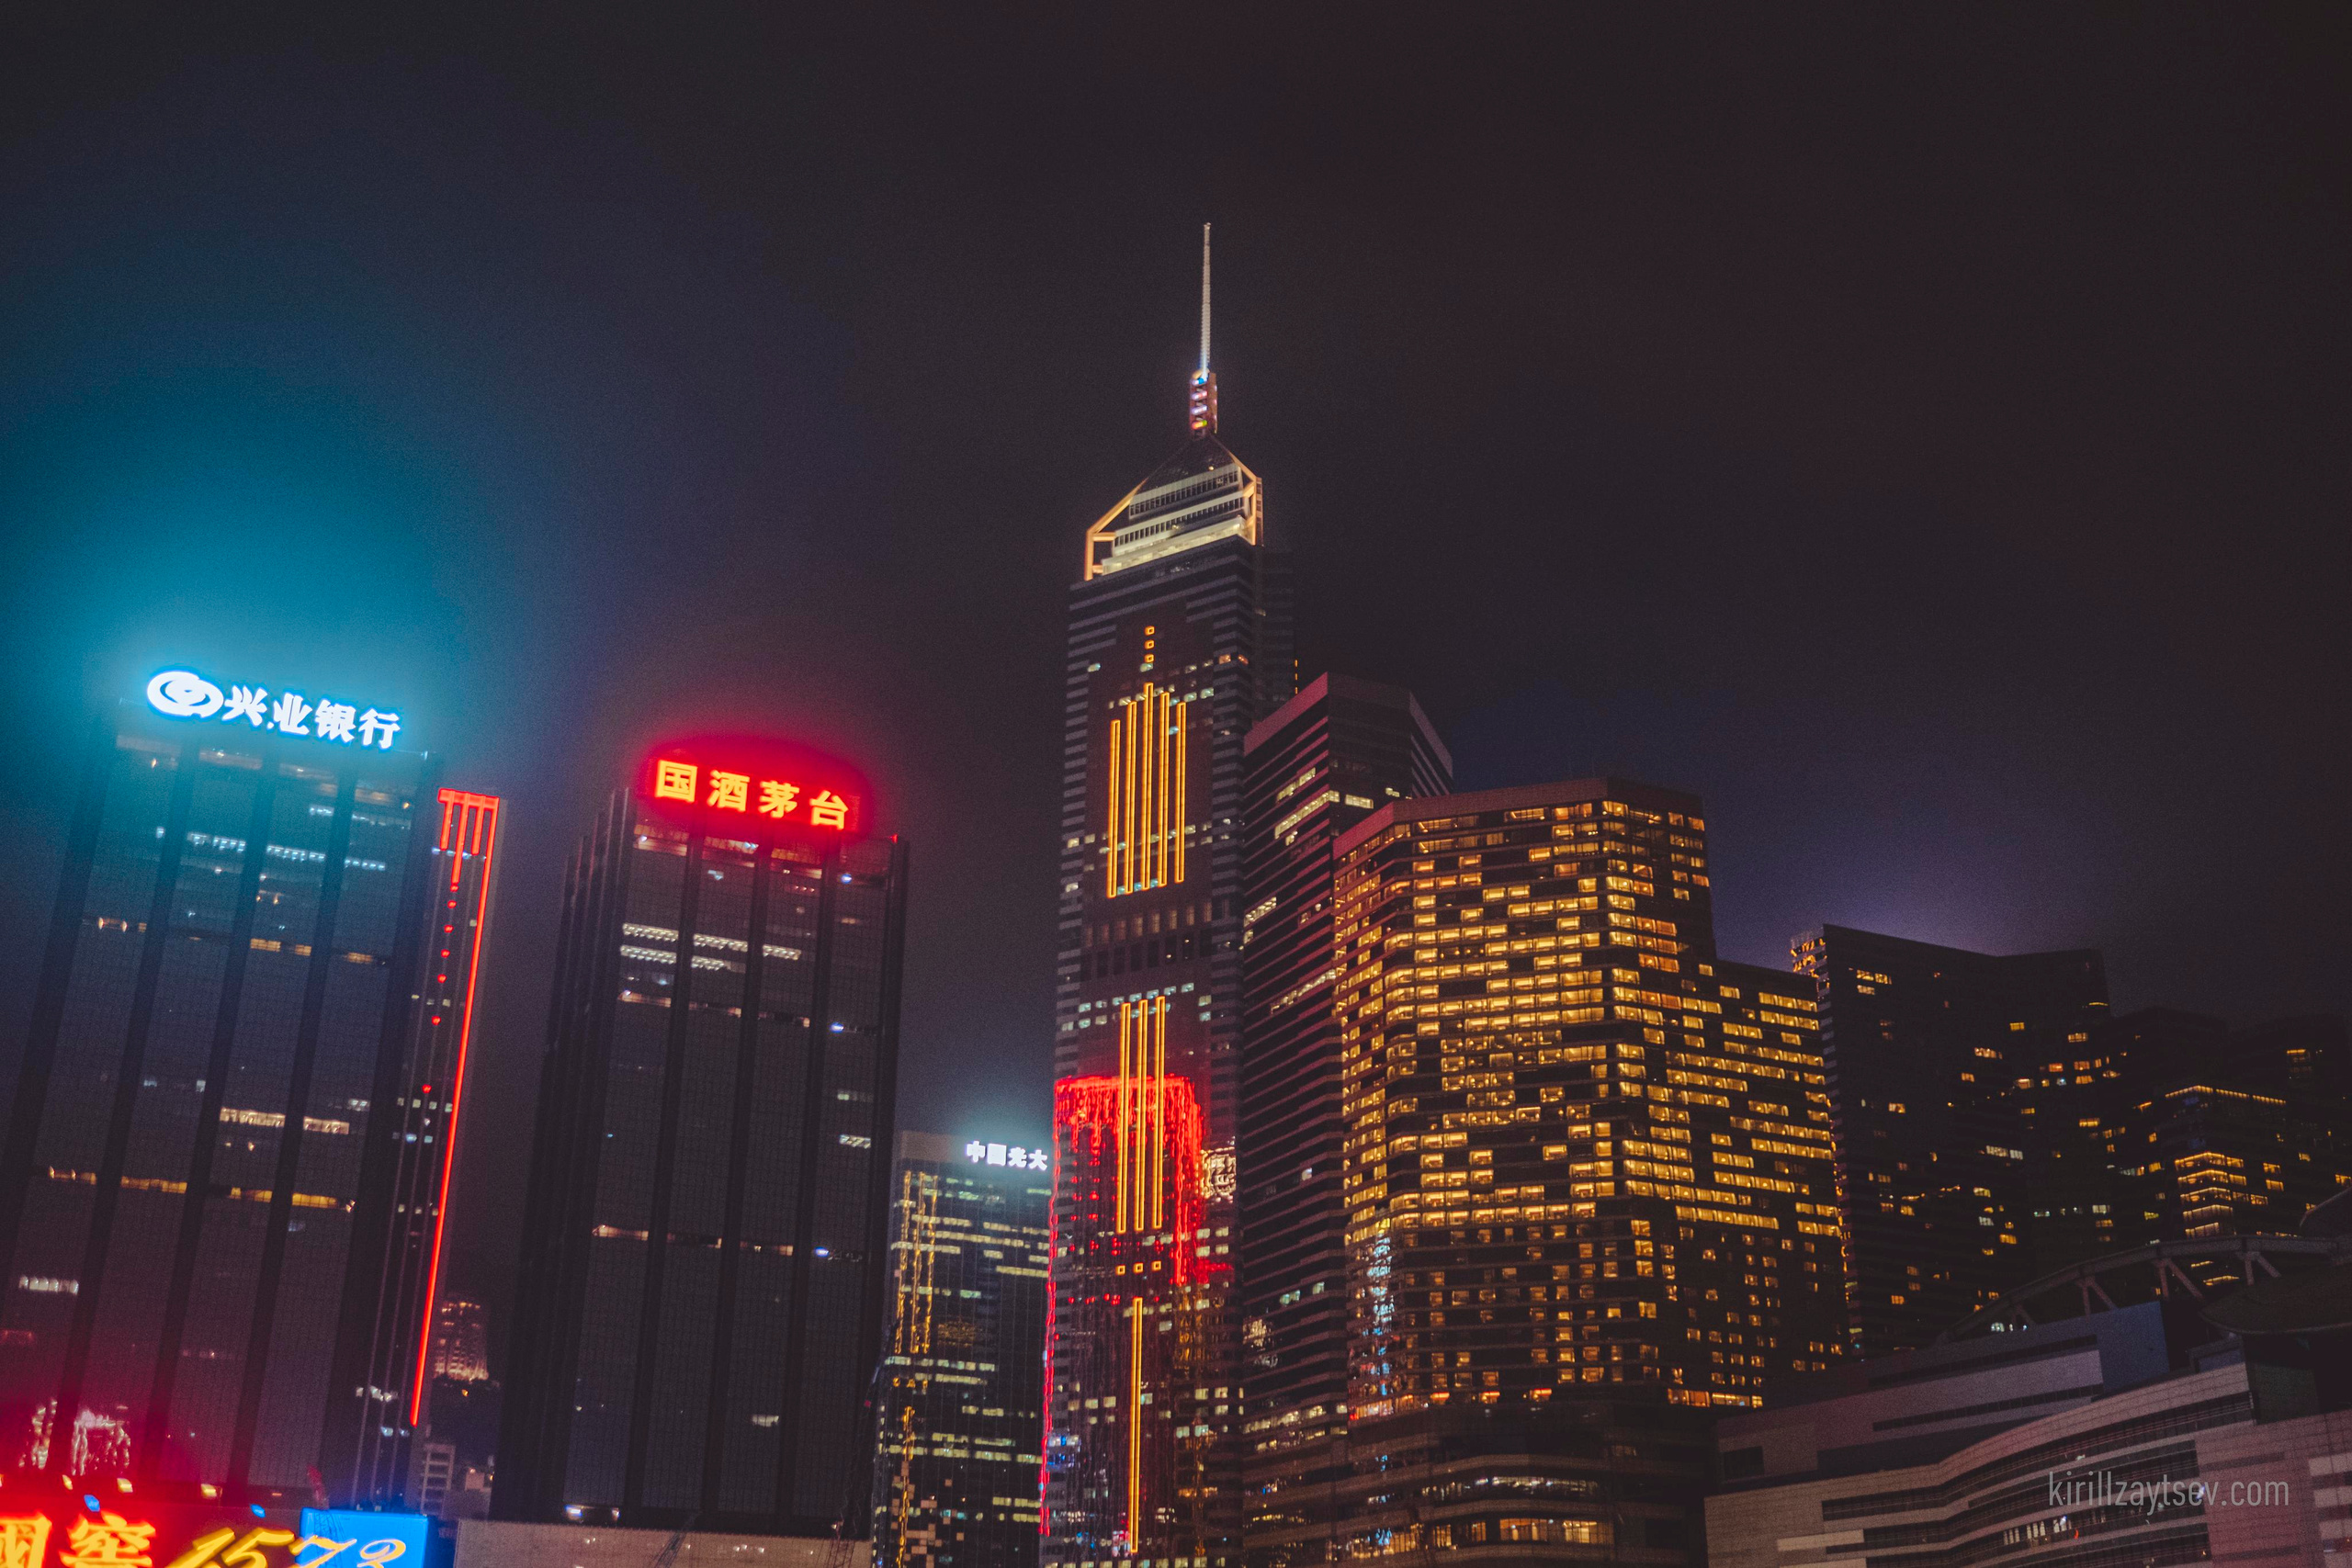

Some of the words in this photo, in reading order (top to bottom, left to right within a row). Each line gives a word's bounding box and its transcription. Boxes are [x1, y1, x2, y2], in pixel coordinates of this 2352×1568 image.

[222, 684, 401, 750] 兴业银行
[655, 760, 849, 829] 国酒茅台
